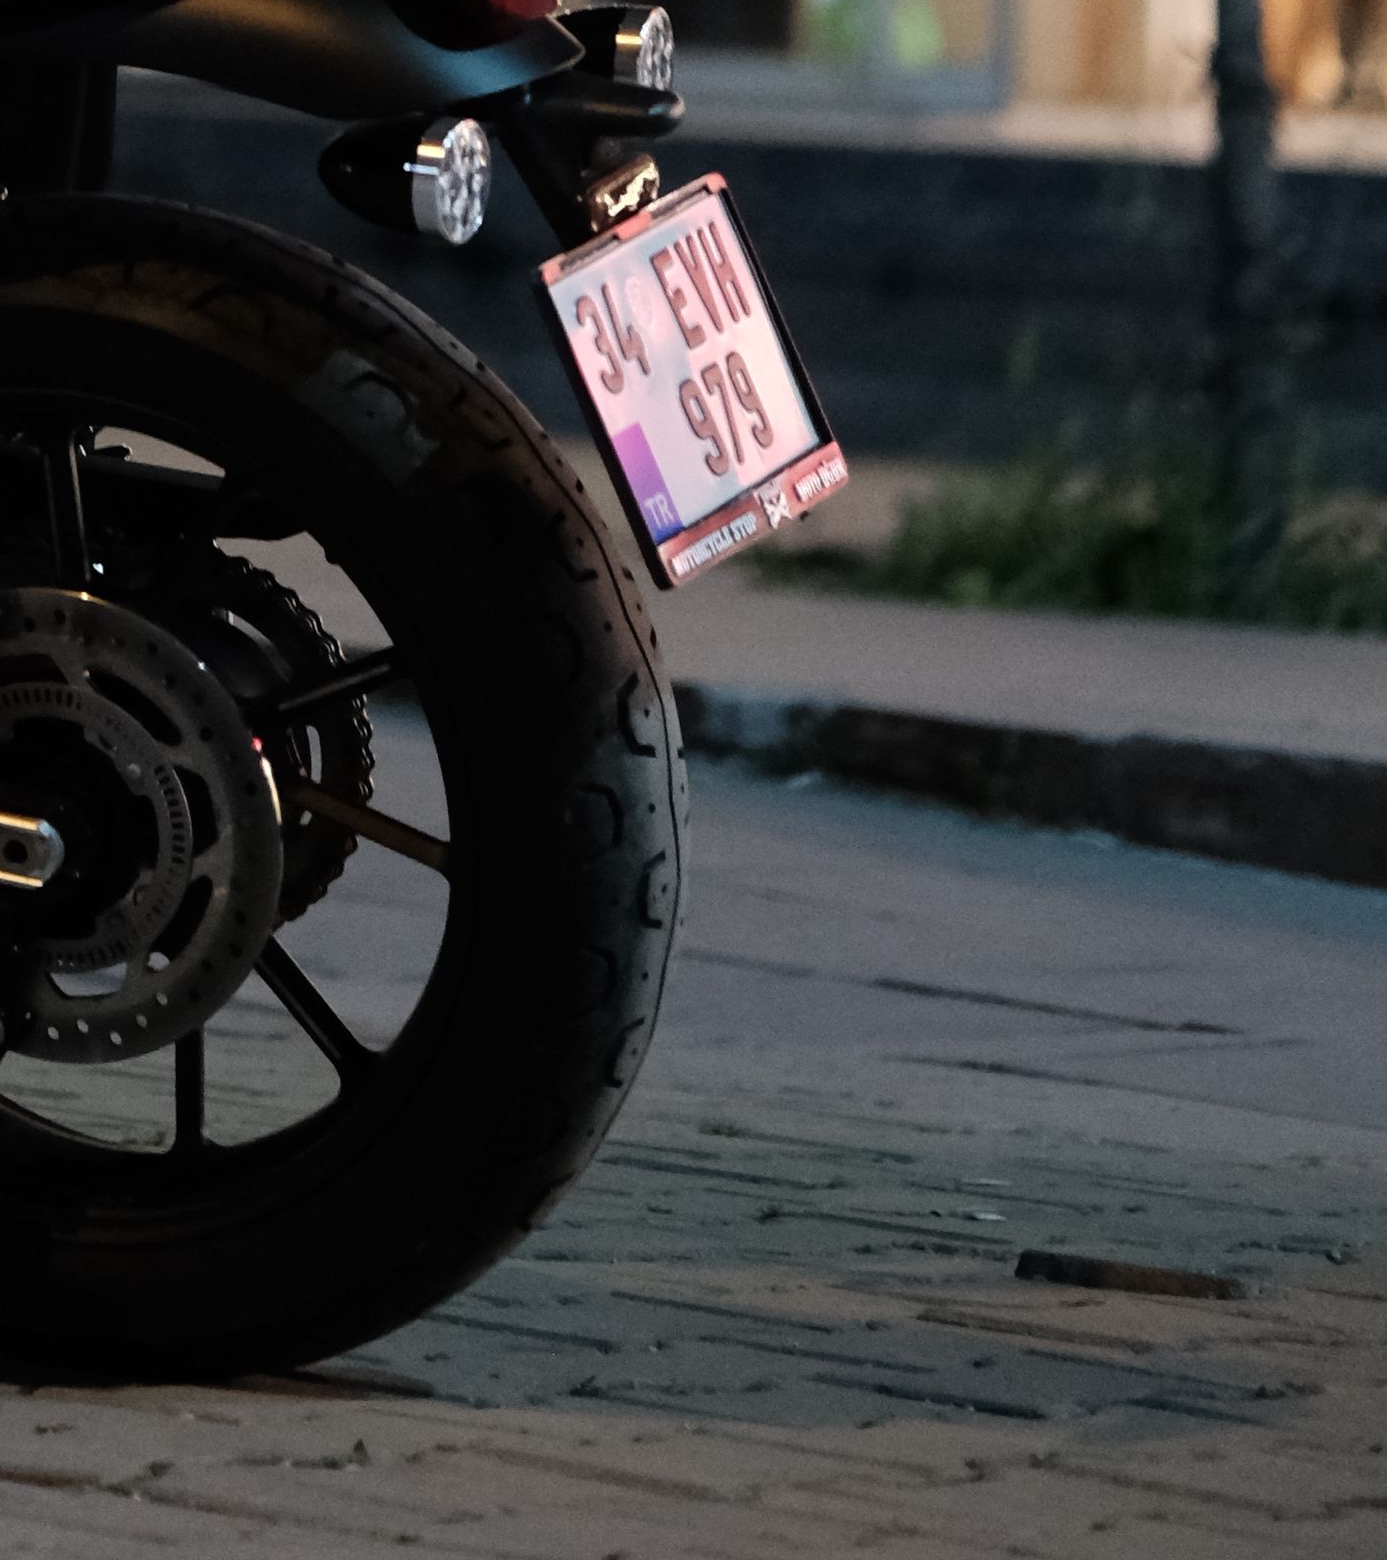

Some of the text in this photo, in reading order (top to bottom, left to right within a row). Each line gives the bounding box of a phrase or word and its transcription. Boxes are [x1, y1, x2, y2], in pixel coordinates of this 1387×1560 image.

[574, 220, 751, 395] 34 EVH
[677, 350, 775, 477] 979
[646, 492, 675, 529] TR
